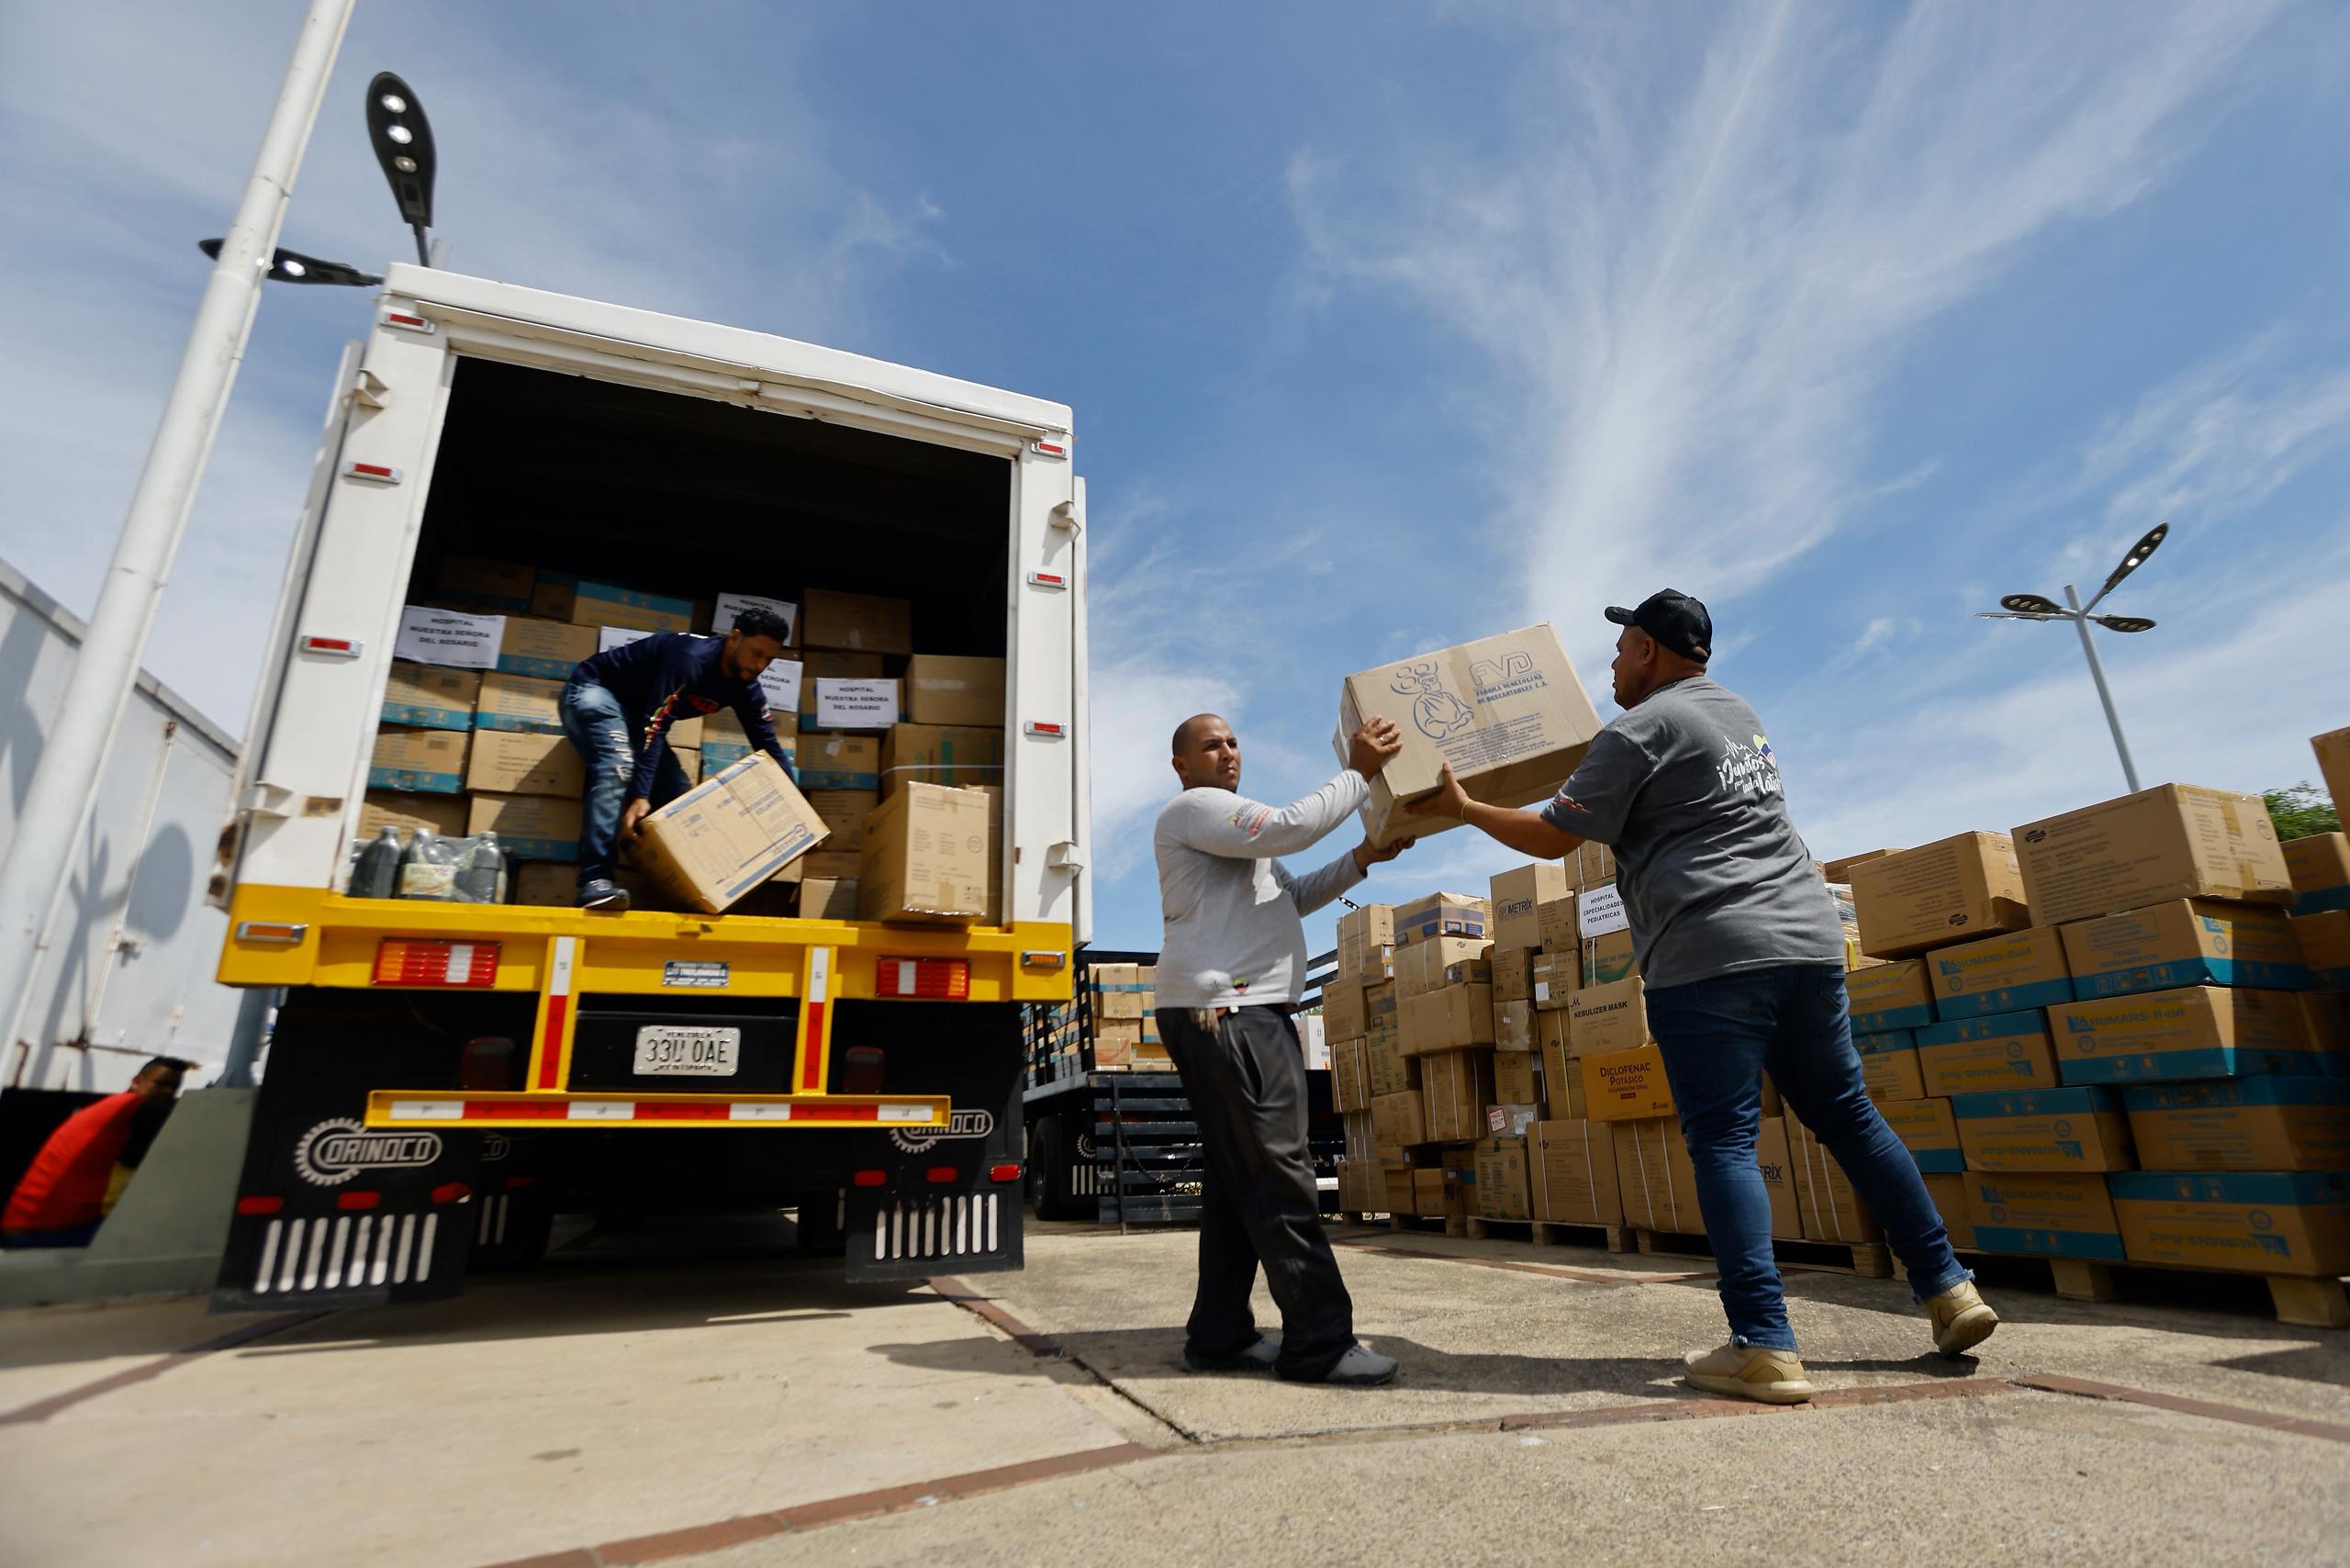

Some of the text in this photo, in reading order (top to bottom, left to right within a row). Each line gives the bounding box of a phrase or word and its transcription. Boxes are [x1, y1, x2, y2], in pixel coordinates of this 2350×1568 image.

[409, 625, 452, 635] NUESTRA
[431, 618, 473, 627] HOSPITAL
[439, 638, 478, 647] ROSARIO
[1469, 651, 1533, 687] FVD
[1590, 893, 1614, 904] HOSPITAL
[1583, 901, 1624, 916] ESPECIALIDADES
[1574, 1002, 1628, 1018] NEBULIZER MASK
[1600, 1062, 1651, 1077] DICLOFENAC
[325, 1137, 432, 1164] ORINOCO
